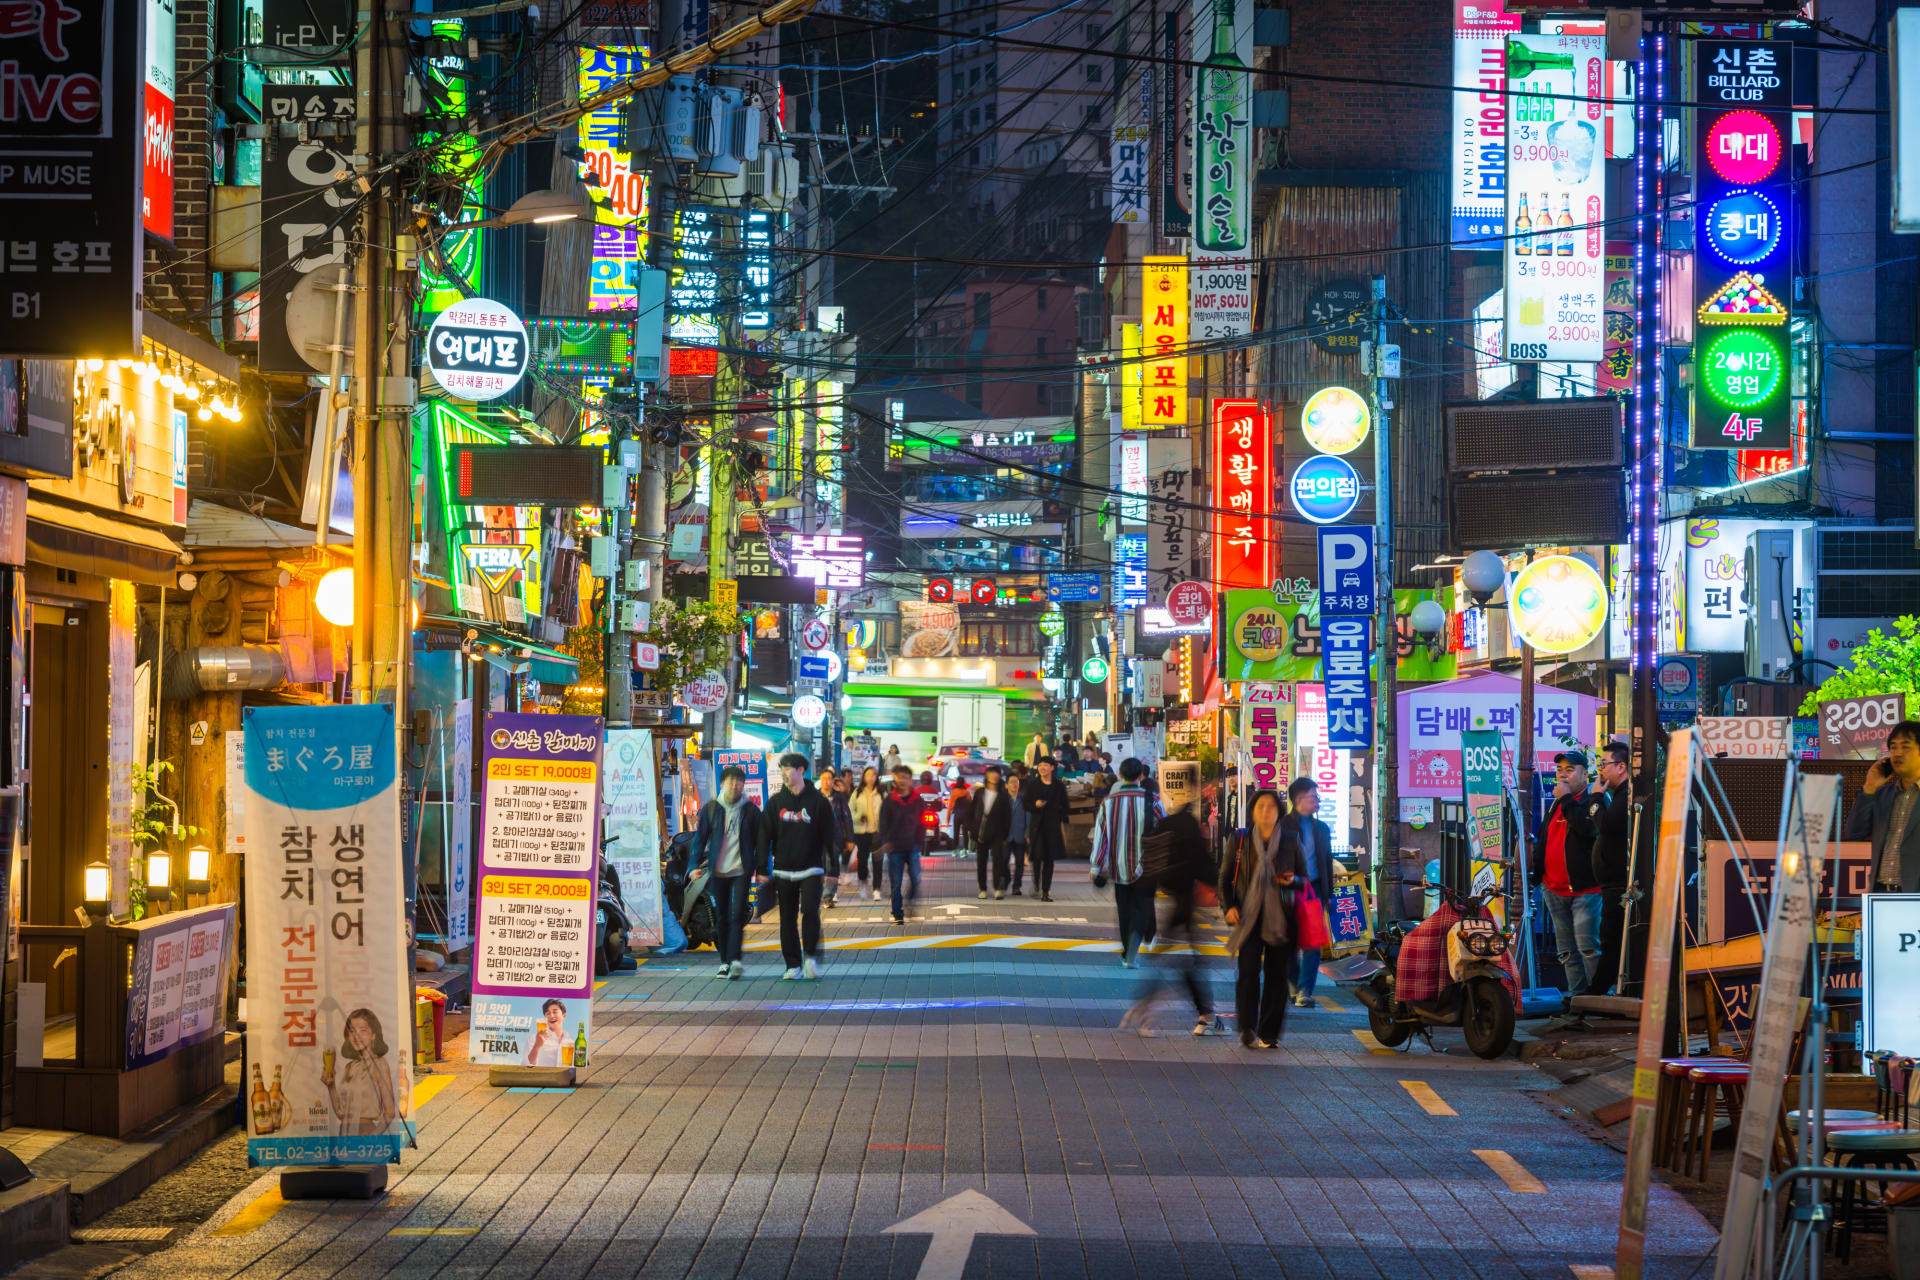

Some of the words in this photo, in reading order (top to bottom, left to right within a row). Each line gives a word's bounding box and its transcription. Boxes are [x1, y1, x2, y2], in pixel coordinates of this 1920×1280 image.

[1712, 47, 1777, 75] 신촌
[1707, 75, 1781, 89] BILLIARD
[1720, 87, 1764, 101] CLUB
[1513, 144, 1569, 163] 9,900원
[1718, 134, 1768, 162] 대대
[1463, 118, 1474, 198] ORIGINAL
[24, 166, 91, 184] MUSE
[1118, 145, 1145, 209] 마사지
[1199, 111, 1250, 244] 참이슬
[1717, 213, 1769, 242] 중대
[52, 241, 112, 273] 호프
[1541, 260, 1598, 278] 9,900원
[1196, 274, 1247, 291] 1,900원
[12, 293, 41, 319] B1
[1557, 293, 1597, 308] 생맥주
[1558, 311, 1596, 323] 500cc
[1548, 326, 1600, 342] 2,900원
[435, 330, 519, 368] 연대포
[1510, 343, 1548, 359] BOSS
[1153, 304, 1177, 419] 서울포차
[446, 373, 504, 390] 김치해물파전
[1726, 376, 1760, 395] 영업
[1722, 412, 1763, 441] 4F
[1228, 416, 1259, 559] 생활맥주
[1296, 476, 1356, 499] 편의점
[466, 547, 523, 568] TERRA
[1322, 533, 1368, 593] P
[1178, 592, 1203, 606] 코인
[1272, 577, 1313, 605] 신촌
[1323, 595, 1370, 610] 주차장
[1174, 605, 1208, 621] 노래방
[1246, 613, 1276, 627] 24시
[1241, 626, 1282, 650] 코인
[1841, 641, 1855, 649] LG
[1326, 621, 1368, 736] 유료주차
[1662, 670, 1688, 683] 담배
[1248, 684, 1292, 703] 24시
[1415, 706, 1471, 736] 담배
[512, 729, 542, 751] 신촌
[543, 729, 596, 753] 갈매기
[266, 744, 374, 772] まぐろ屋
[1464, 746, 1500, 772] BOSS
[492, 764, 511, 777] 2인
[514, 764, 539, 778] SET
[333, 776, 374, 787] 마구로야
[1165, 780, 1184, 790] BEER
[512, 786, 548, 797] 갈매기살
[548, 788, 572, 798] (340g)
[494, 798, 520, 808] 껍데기
[521, 800, 543, 810] (100g)
[552, 800, 587, 811] 된장찌개
[543, 813, 553, 822] or
[556, 812, 583, 823] 음료(1)
[556, 829, 579, 839] (340g)
[492, 839, 518, 850] 껍데기
[519, 841, 541, 850] (100g)
[550, 841, 586, 852] 된장찌개
[280, 824, 318, 906] 참치
[541, 855, 551, 863] or
[554, 853, 581, 865] 음료(1)
[329, 822, 366, 947] 생연어
[485, 881, 505, 894] 3인
[508, 883, 532, 895] SET
[508, 903, 543, 914] 갈매기살
[543, 907, 565, 916] (510g)
[1336, 897, 1362, 937] 주차
[488, 916, 515, 926] 껍데기
[516, 918, 537, 927] (100g)
[547, 918, 582, 929] 된장찌개
[537, 932, 548, 940] or
[550, 931, 579, 941] 음료(2)
[551, 949, 573, 959] (510g)
[486, 958, 513, 969] 껍데기
[513, 960, 536, 969] (100g)
[545, 960, 580, 972] 된장찌개
[280, 923, 318, 1048] 전문점
[548, 973, 578, 984] 음료(2)
[480, 1040, 520, 1055] TERRA
[255, 1144, 393, 1161] TEL.02-3144-3725
